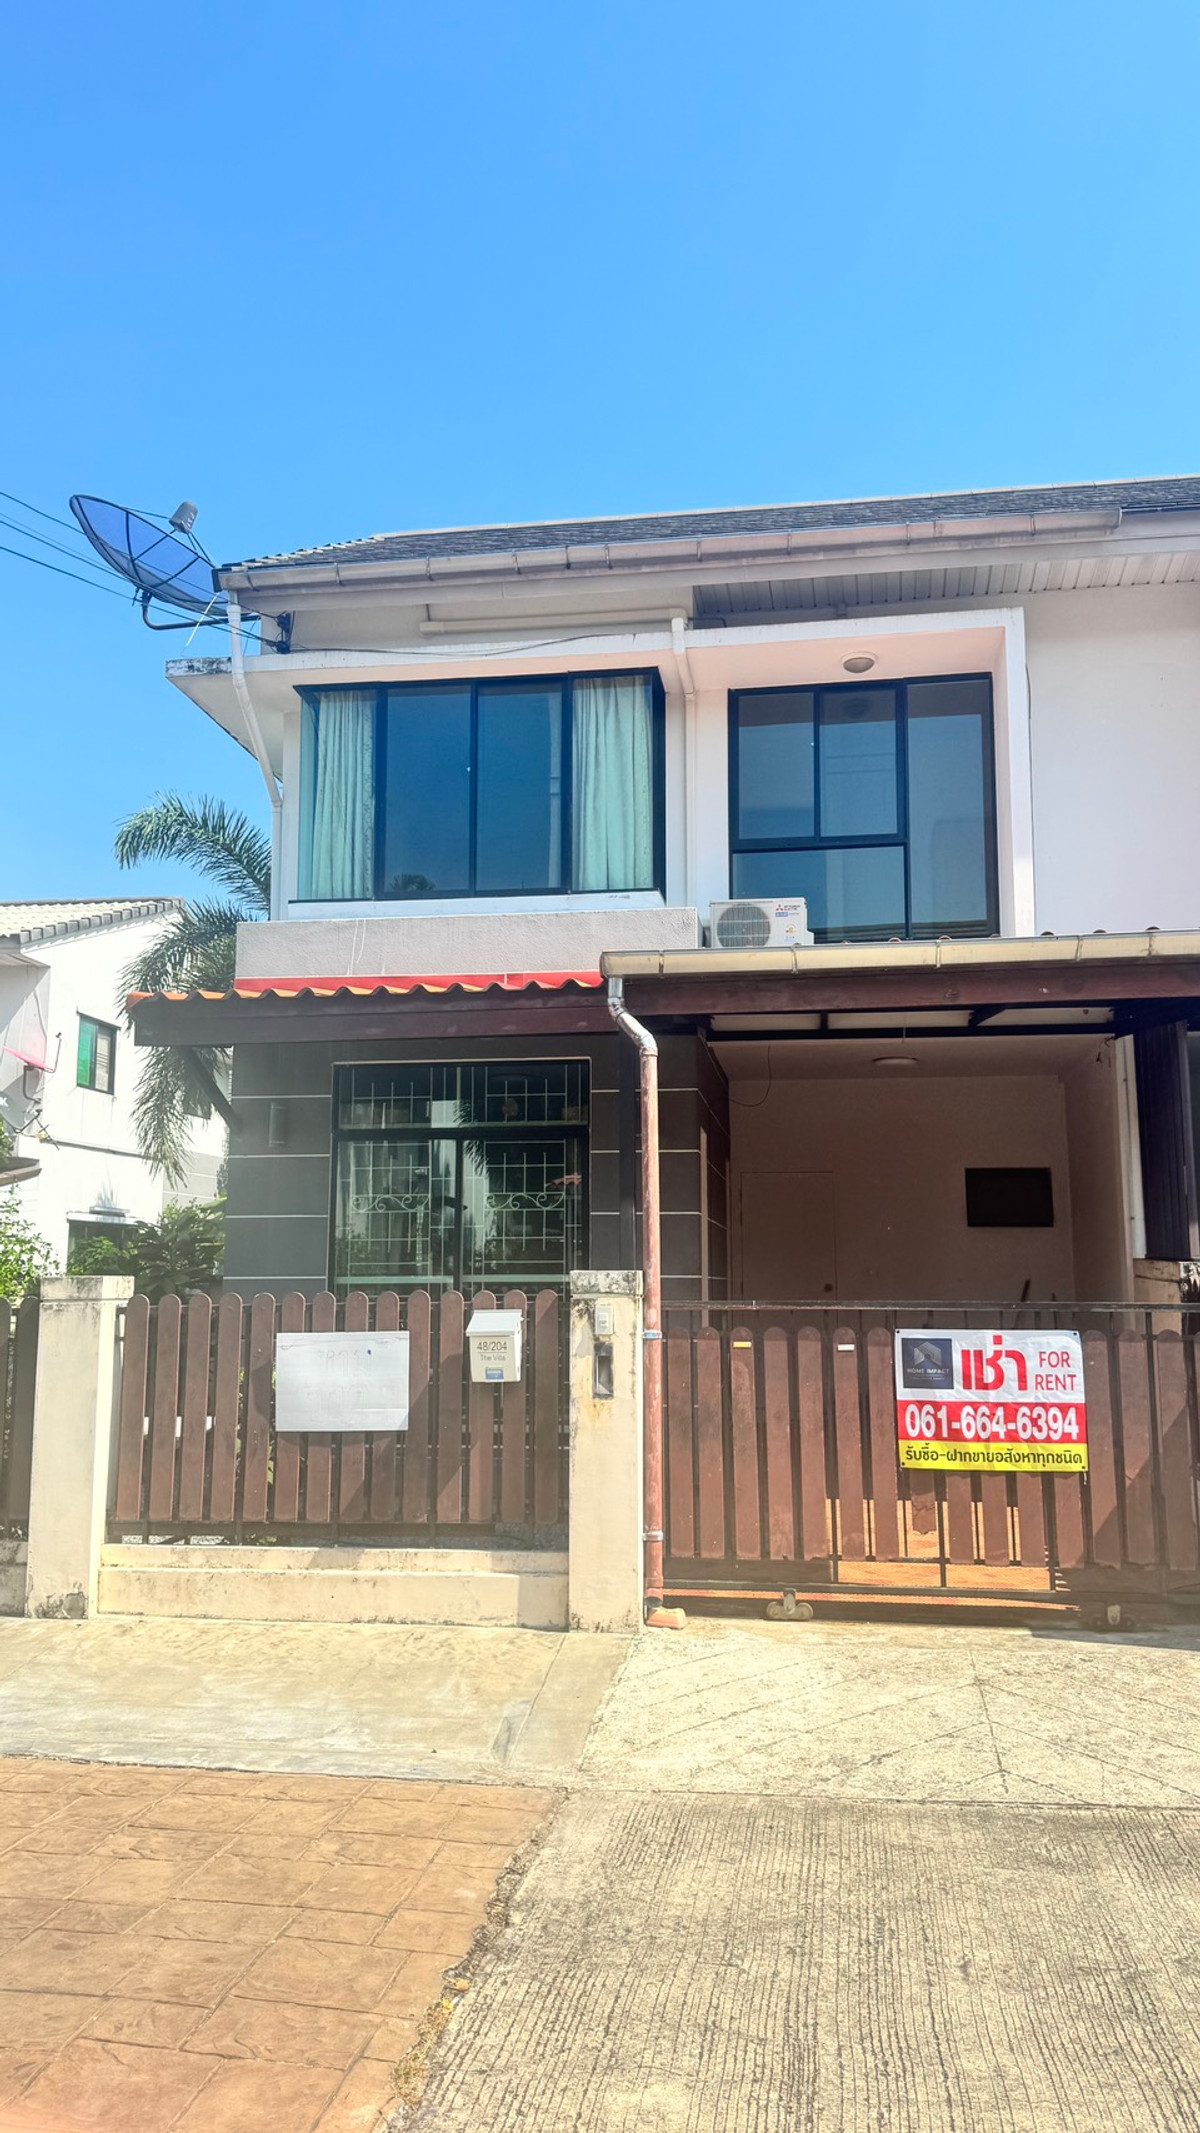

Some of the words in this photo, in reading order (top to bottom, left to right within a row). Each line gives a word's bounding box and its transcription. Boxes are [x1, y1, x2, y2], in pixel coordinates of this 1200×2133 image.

[477, 1341, 507, 1351] 48/204
[961, 1335, 1028, 1391] เช่า
[1038, 1351, 1070, 1368] FOR
[1034, 1374, 1077, 1391] RENT
[905, 1404, 1079, 1440] 061-664-6394
